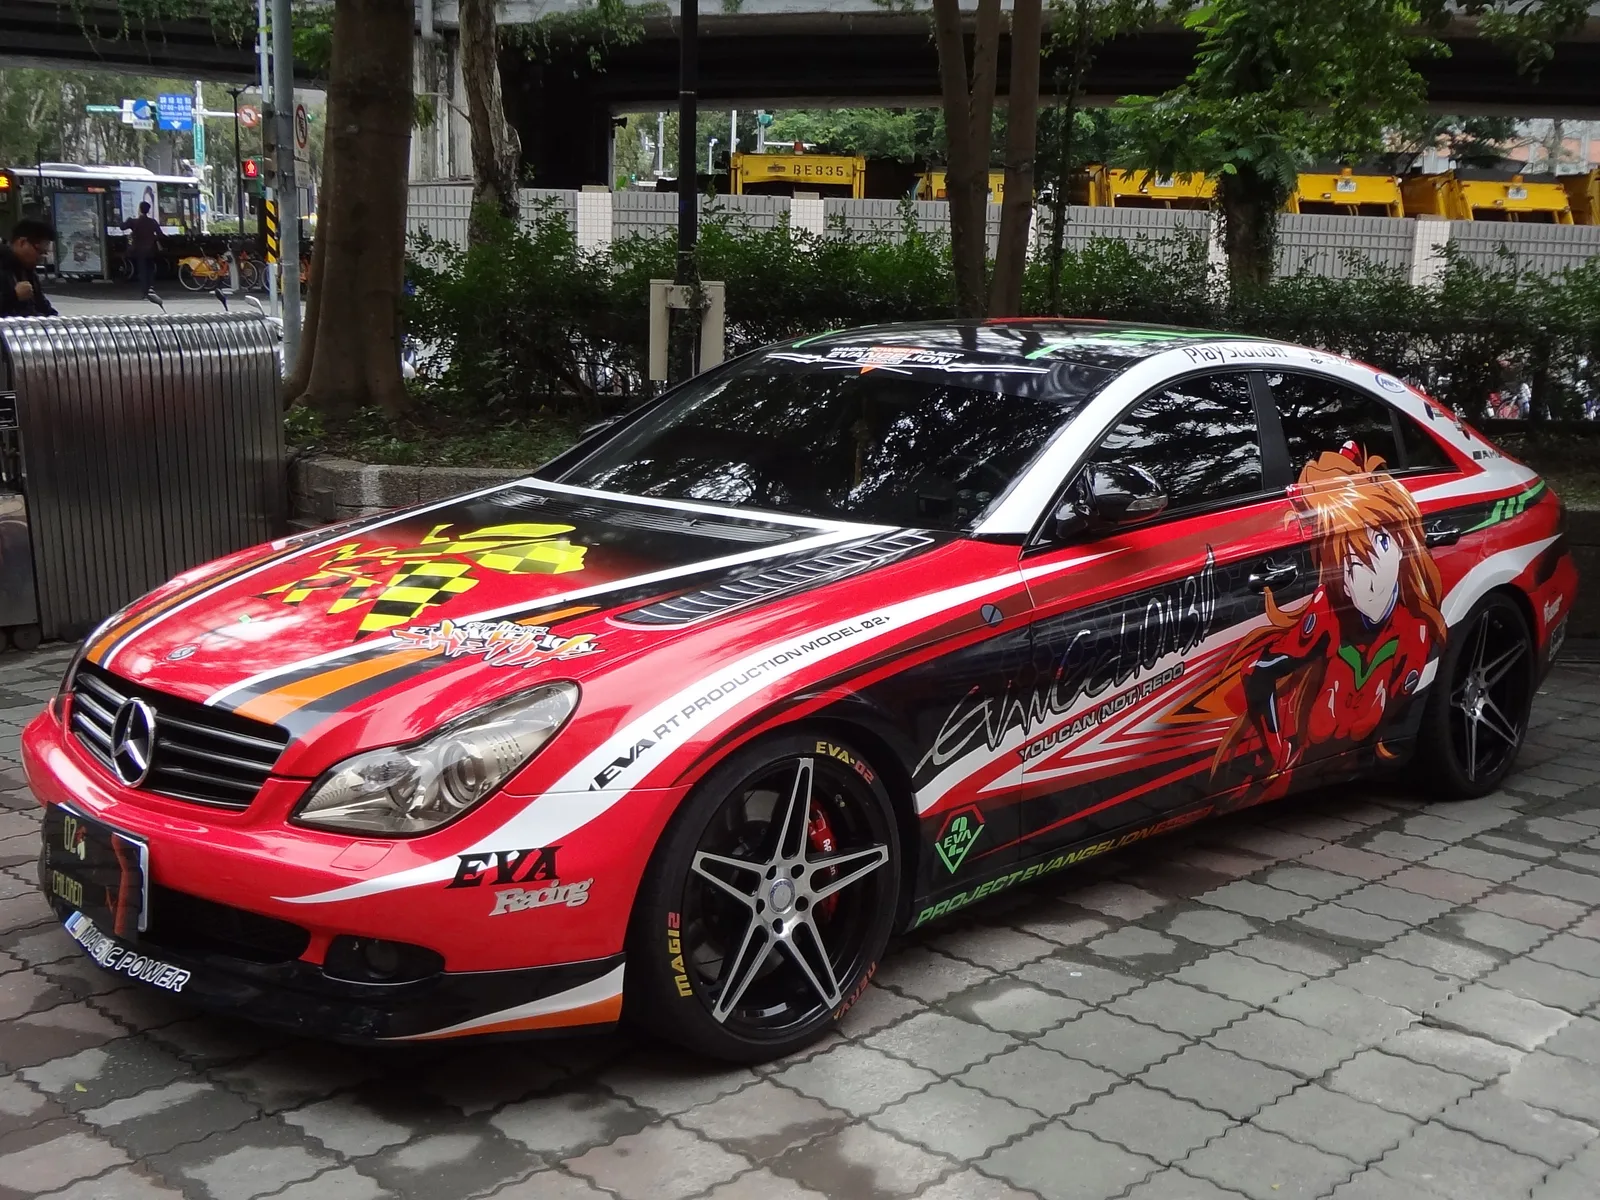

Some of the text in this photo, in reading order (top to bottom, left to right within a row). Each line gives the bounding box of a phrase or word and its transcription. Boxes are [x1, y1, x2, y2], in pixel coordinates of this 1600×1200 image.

[793, 164, 844, 177] BE835
[826, 351, 952, 364] EVANGELION
[908, 349, 964, 358] PROJECT
[1183, 346, 1288, 364] PlayStation
[681, 647, 803, 719] PRODUCTION
[800, 626, 863, 653] MODEL
[1017, 661, 1185, 763] YOU CAN (NOT) REDO
[816, 741, 874, 784] EVA-02
[64, 815, 77, 854] 02
[943, 829, 972, 849] EVA
[444, 845, 564, 889] EVA
[914, 826, 1158, 928] PROJECT EVANGELION
[488, 877, 595, 916] Racing
[79, 923, 191, 992] MAGIC POWER
